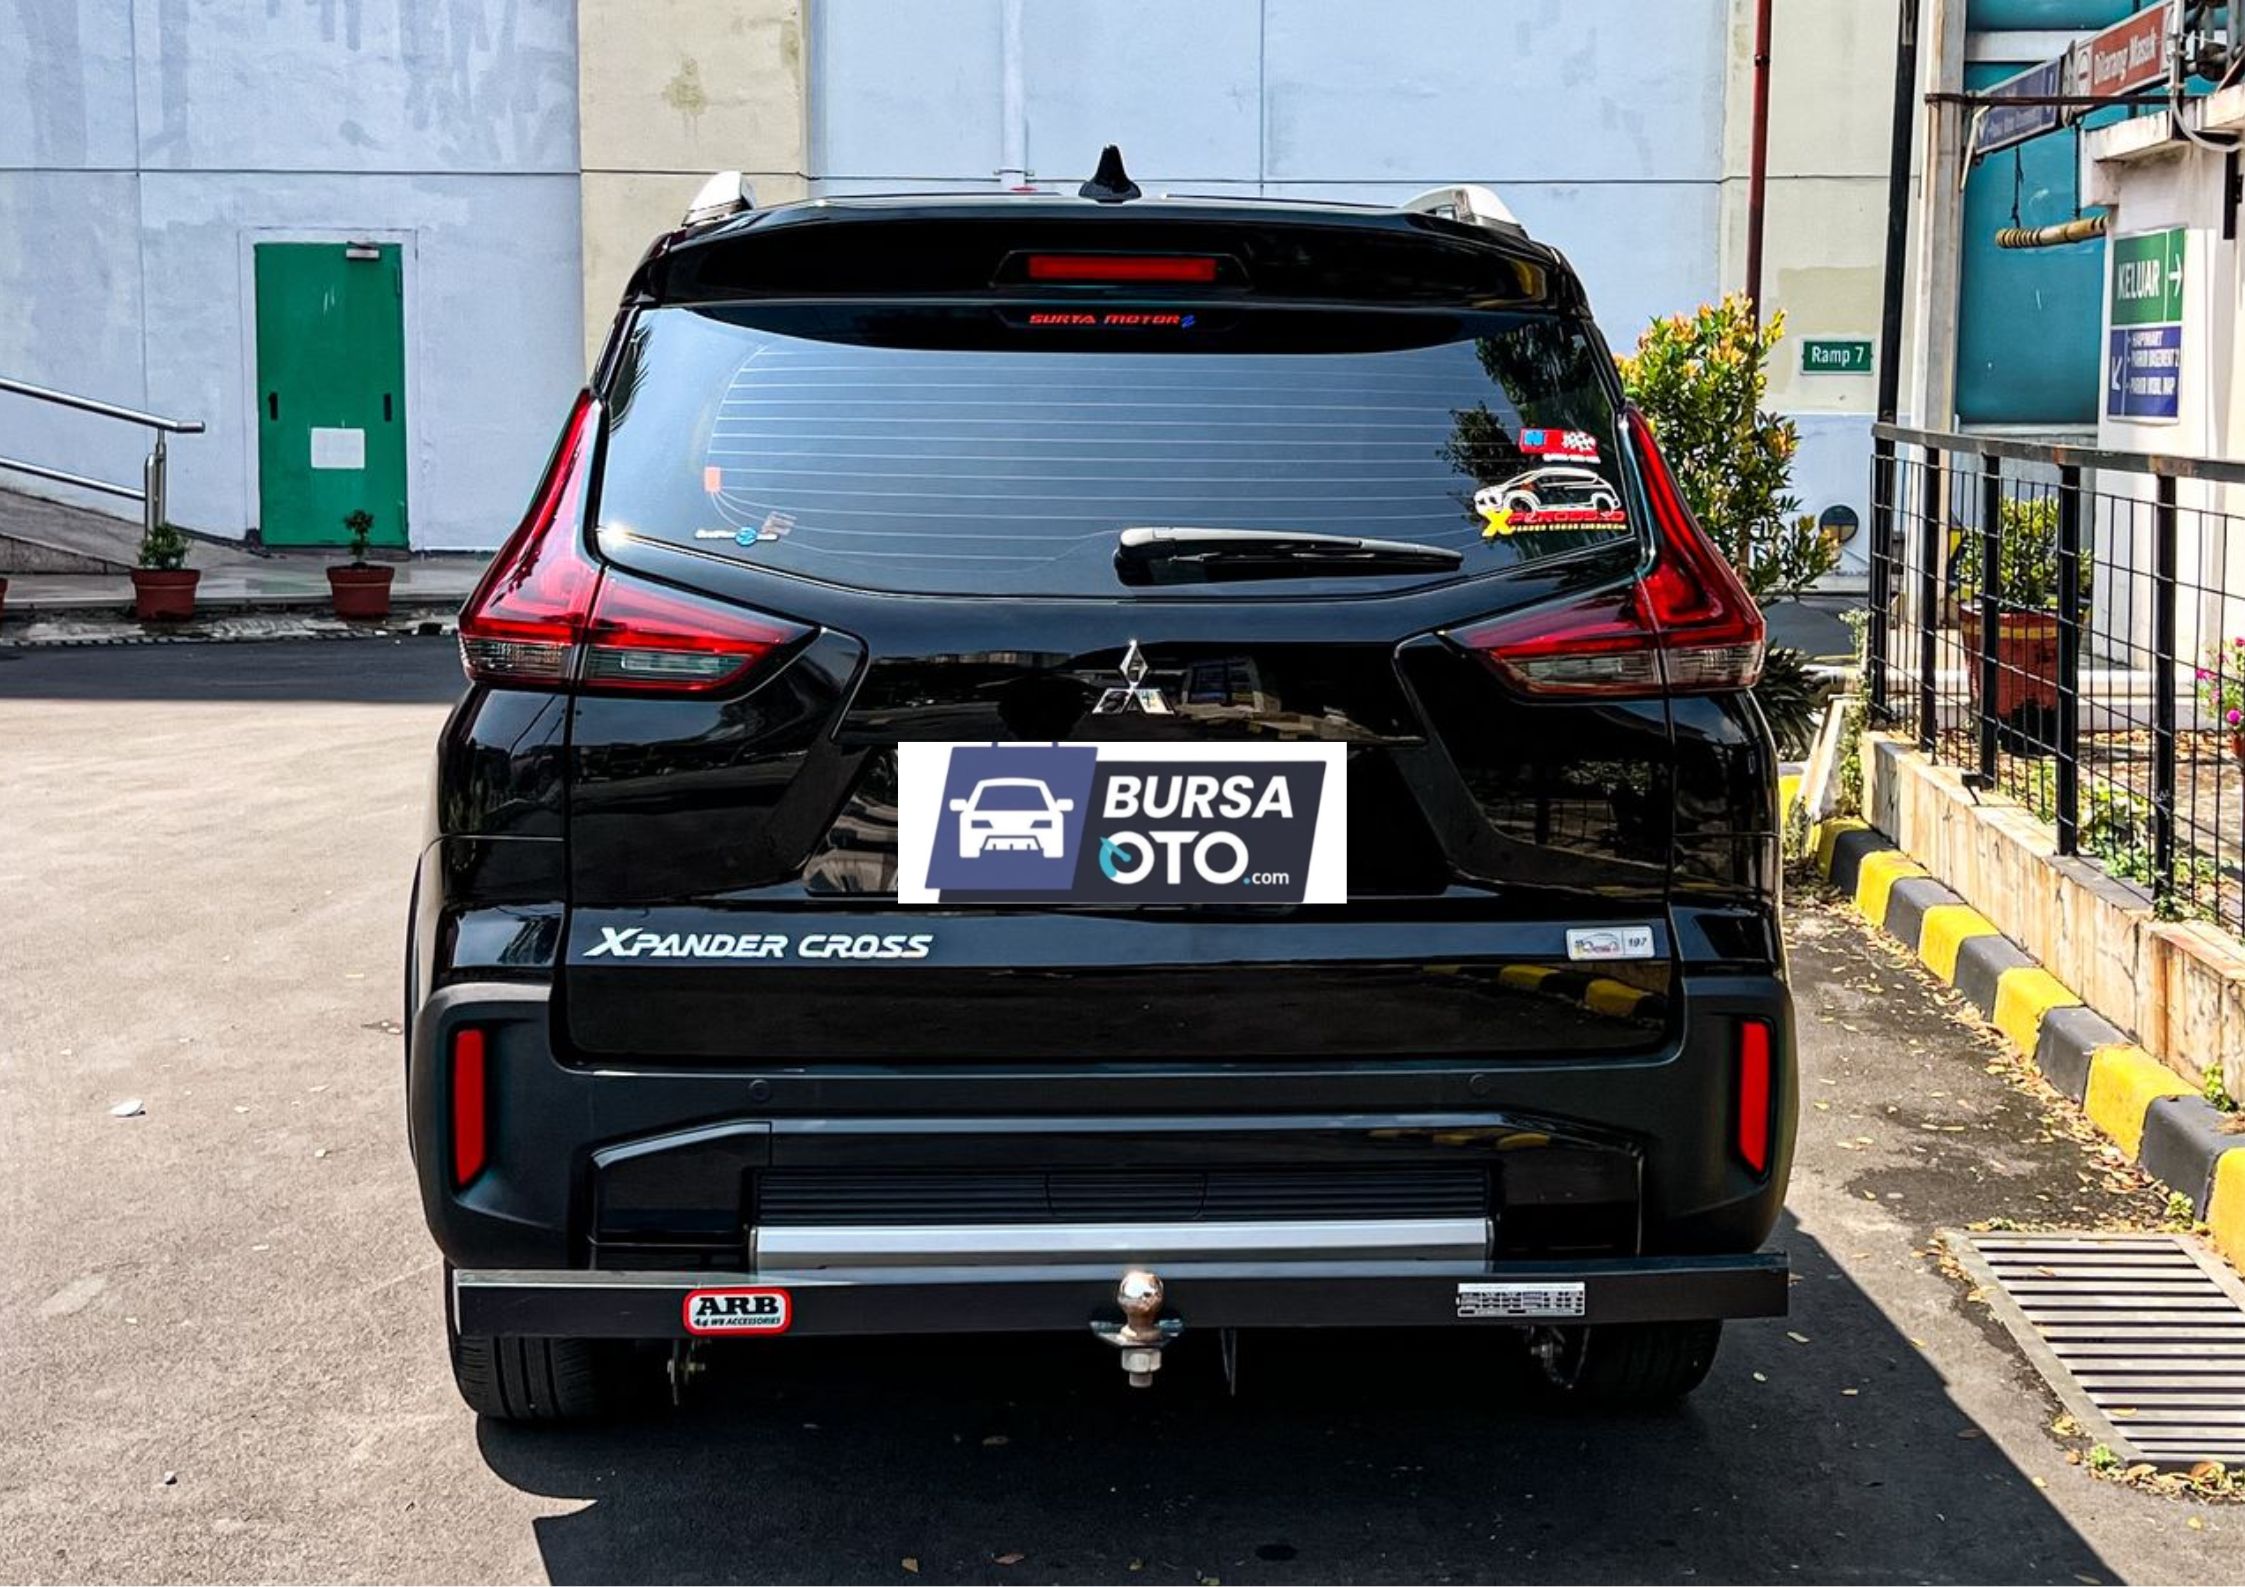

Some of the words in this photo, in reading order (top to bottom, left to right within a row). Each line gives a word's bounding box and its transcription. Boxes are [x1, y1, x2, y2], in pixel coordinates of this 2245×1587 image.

[2117, 259, 2160, 299] KELUAR
[1103, 313, 1181, 325] MOTOR
[1811, 345, 1850, 367] Ramp
[1854, 345, 1864, 363] 7
[582, 927, 789, 958] XPANDER
[798, 934, 934, 959] CROSS
[695, 1296, 779, 1316] ARB
